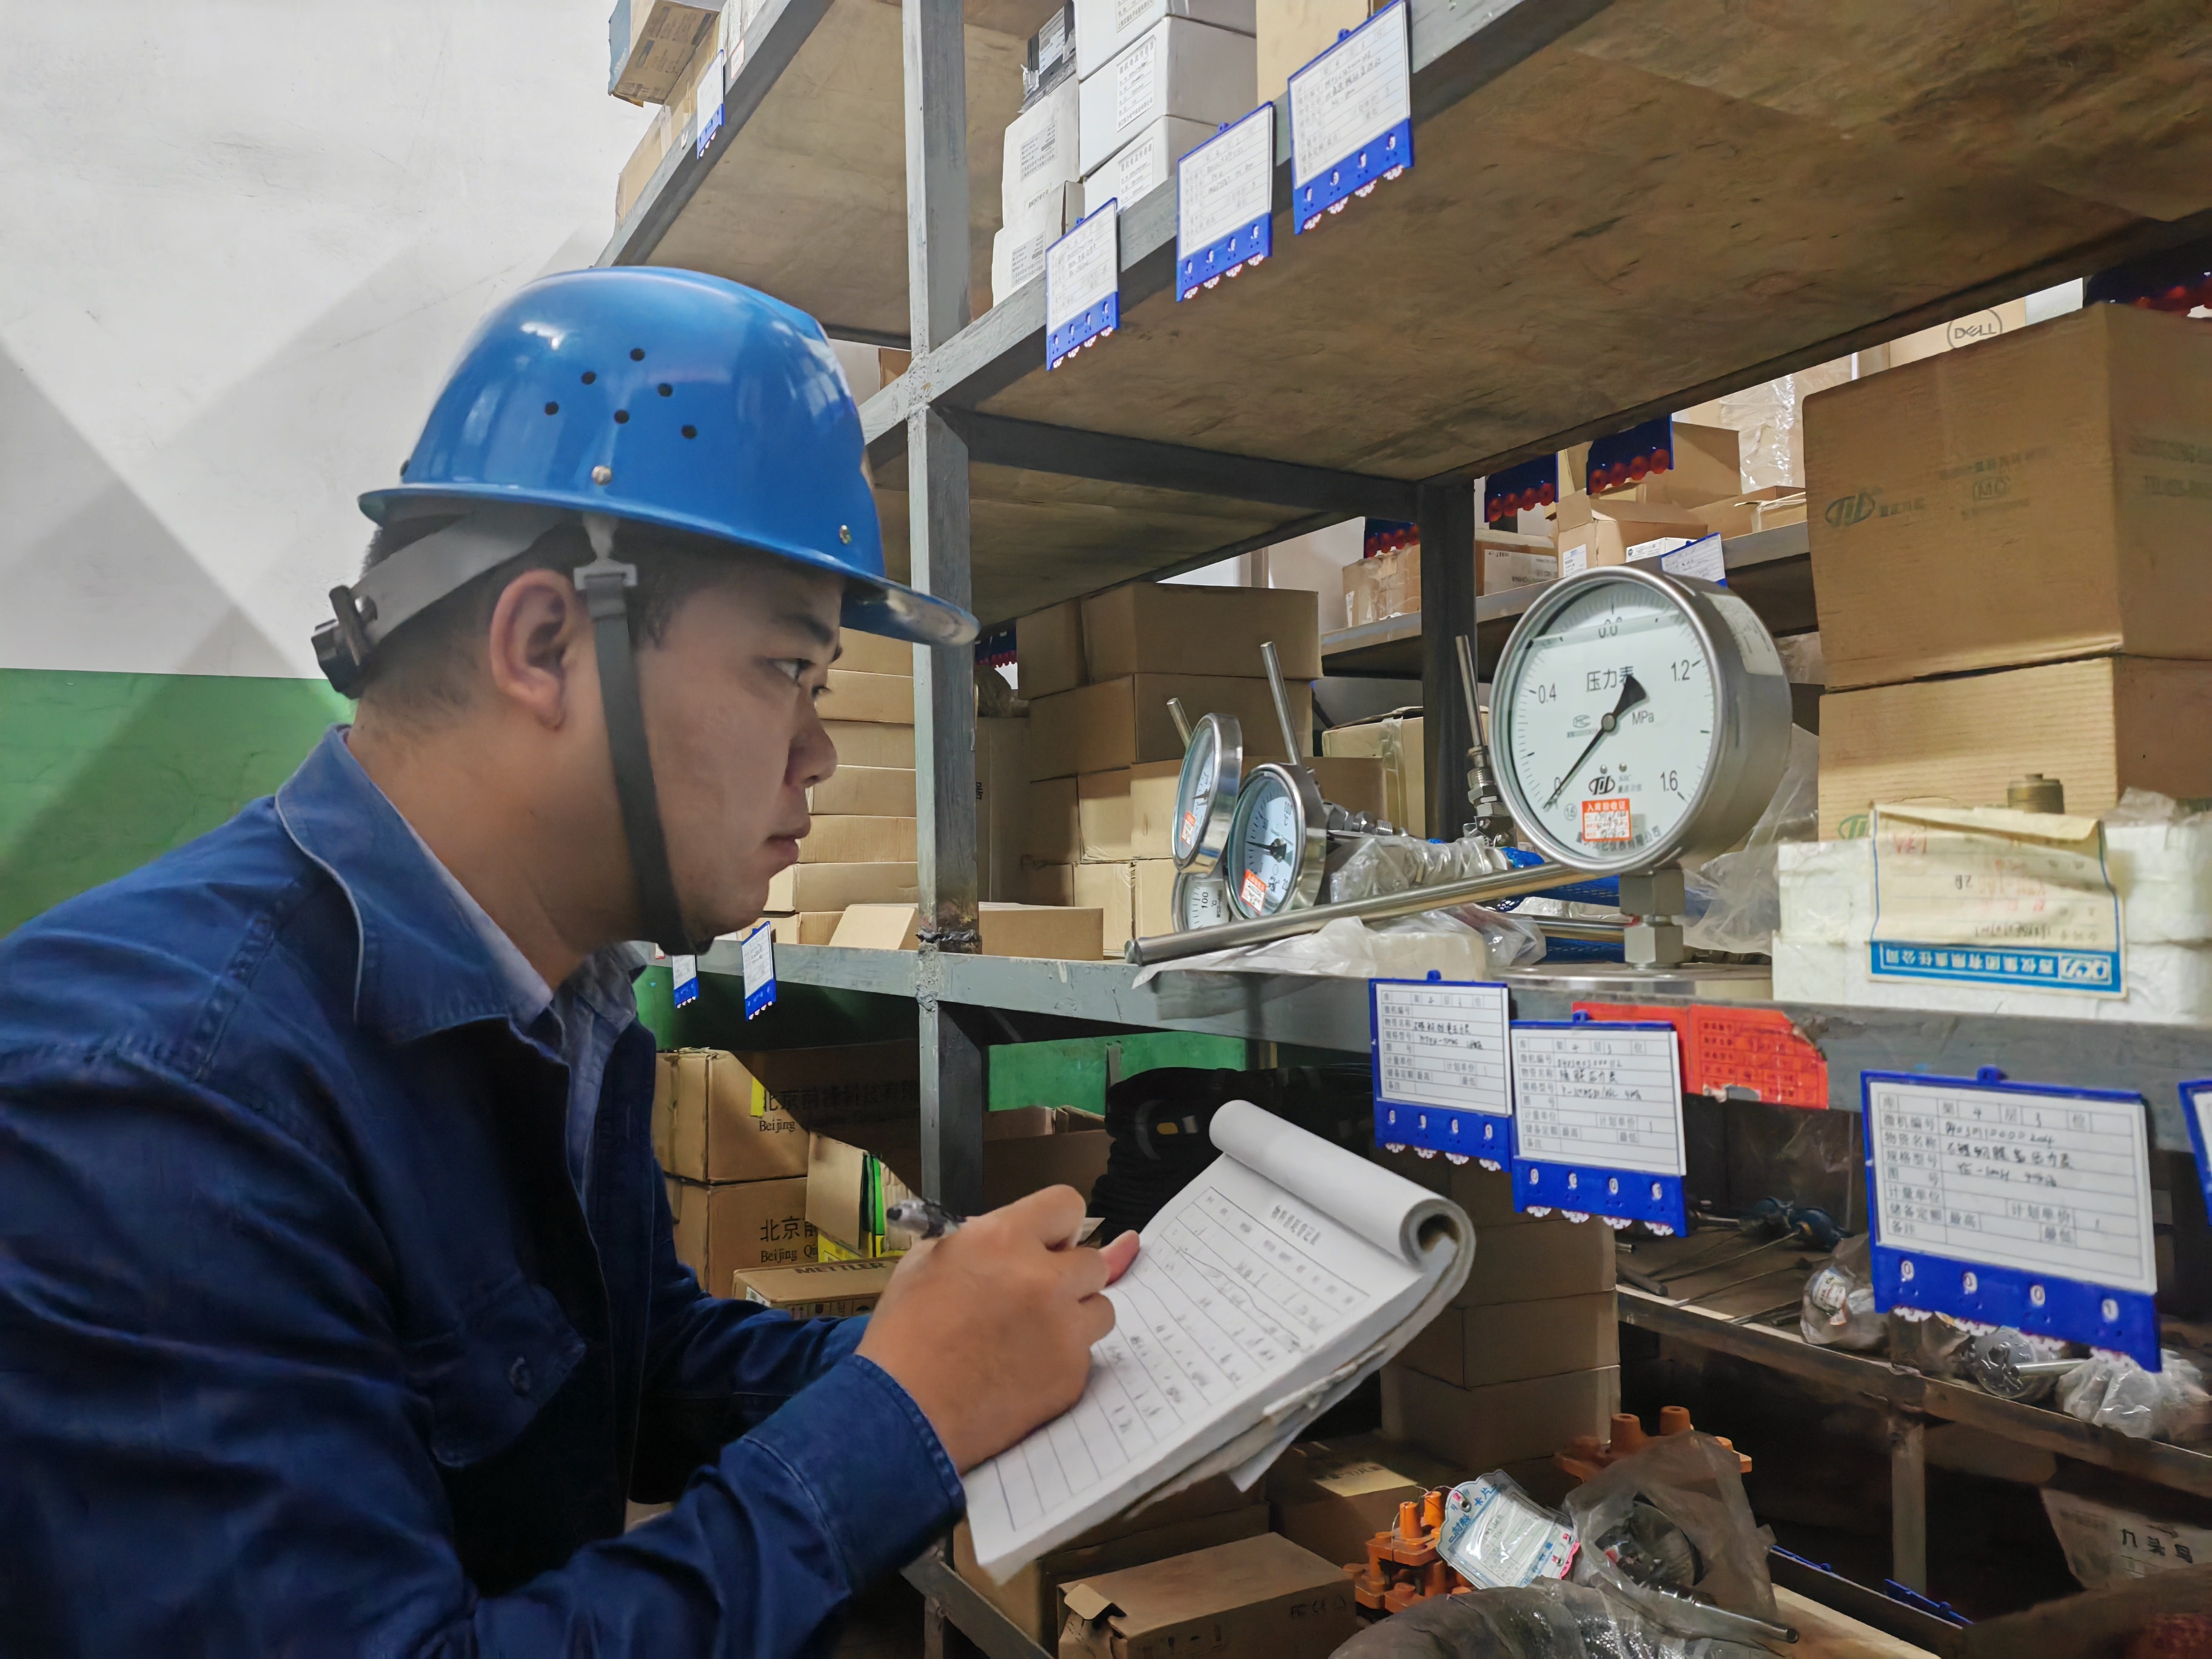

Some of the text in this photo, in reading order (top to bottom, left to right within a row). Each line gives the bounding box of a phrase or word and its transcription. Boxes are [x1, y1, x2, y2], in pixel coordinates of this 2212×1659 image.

[1954, 323, 1997, 340] DELL
[1586, 666, 1634, 692] 压力表
[1671, 659, 1691, 682] 1.2
[1538, 683, 1557, 705] 0.4
[1632, 710, 1655, 725] MPa
[1660, 770, 1678, 792] 1.6
[759, 1118, 796, 1133] Beijing
[1883, 1114, 1936, 1132] 微机编号
[1884, 1131, 1937, 1149] 物资名称
[1885, 1150, 1937, 1168] 规格型号
[1889, 1187, 1940, 1204] 计量单位
[2011, 1202, 2072, 1225] 计划单价
[1889, 1204, 1942, 1222] 储备定额
[761, 1247, 798, 1264] Beijing
[794, 1262, 888, 1275] METTLER
